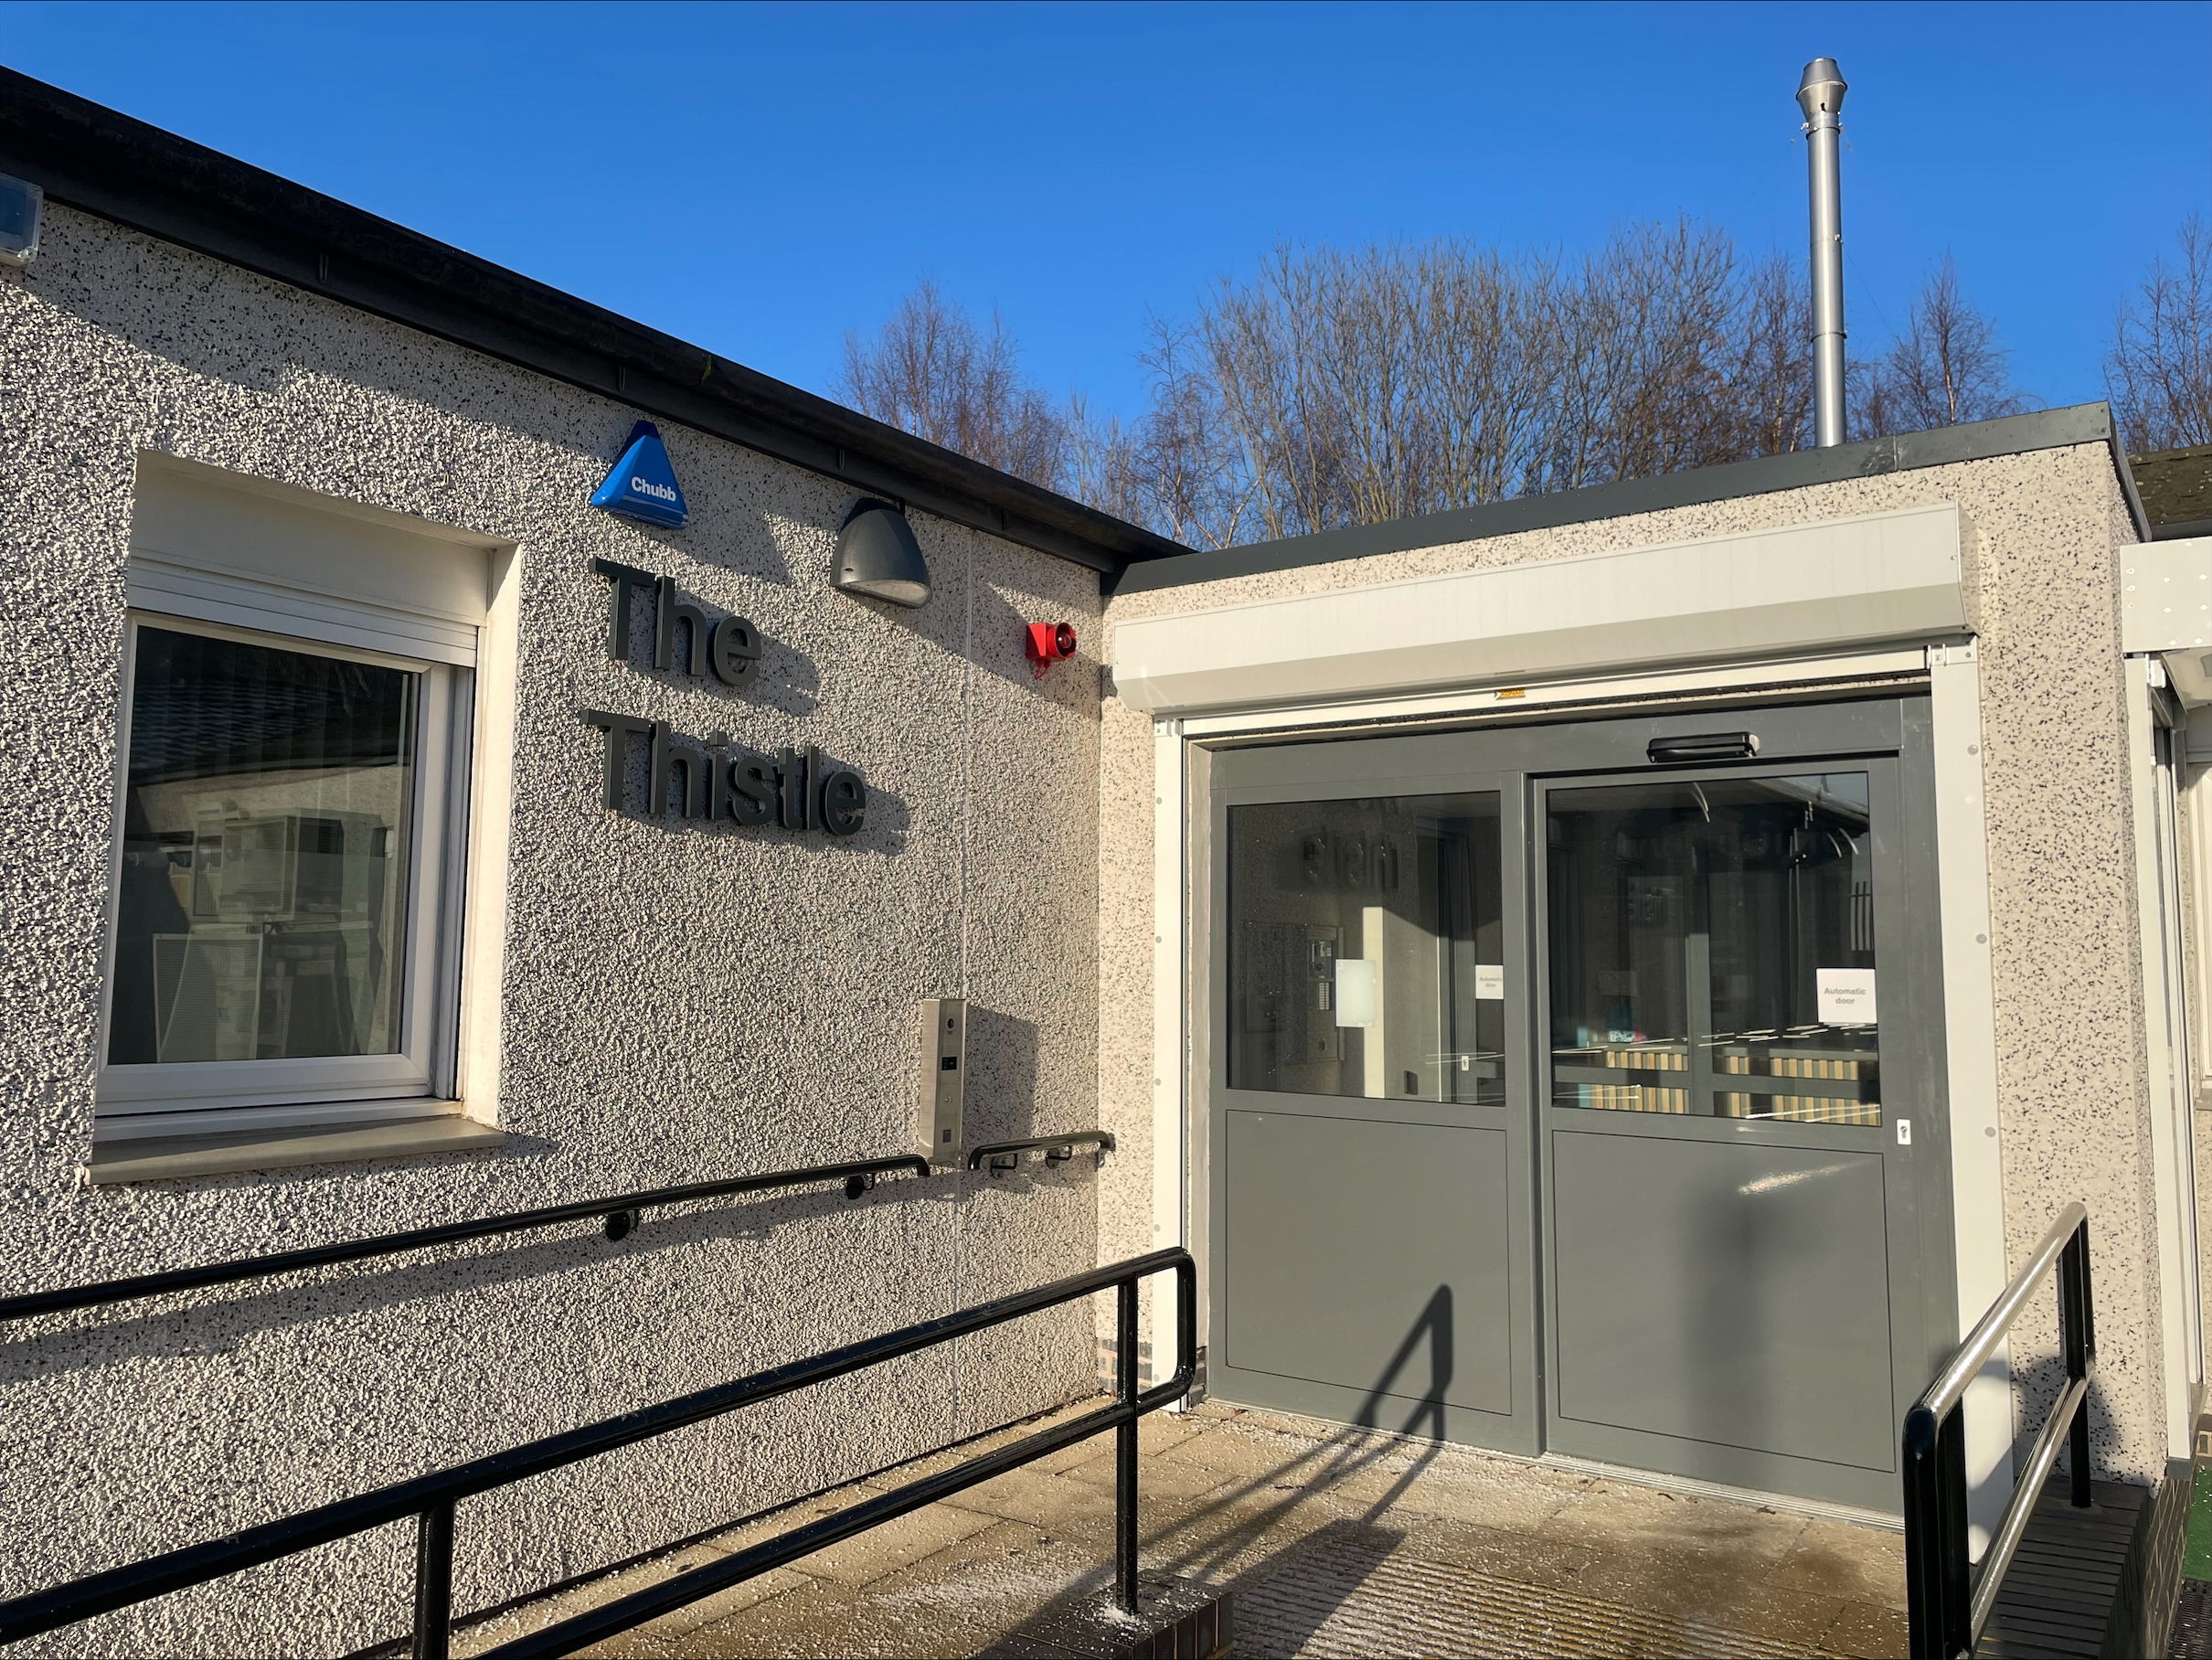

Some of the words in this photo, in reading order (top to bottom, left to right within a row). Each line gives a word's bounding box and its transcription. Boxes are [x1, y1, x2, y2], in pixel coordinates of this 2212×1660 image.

[631, 476, 676, 502] Chubb
[589, 556, 761, 686] The
[580, 708, 867, 836] Thistle
[1824, 987, 1866, 995] Automatic
